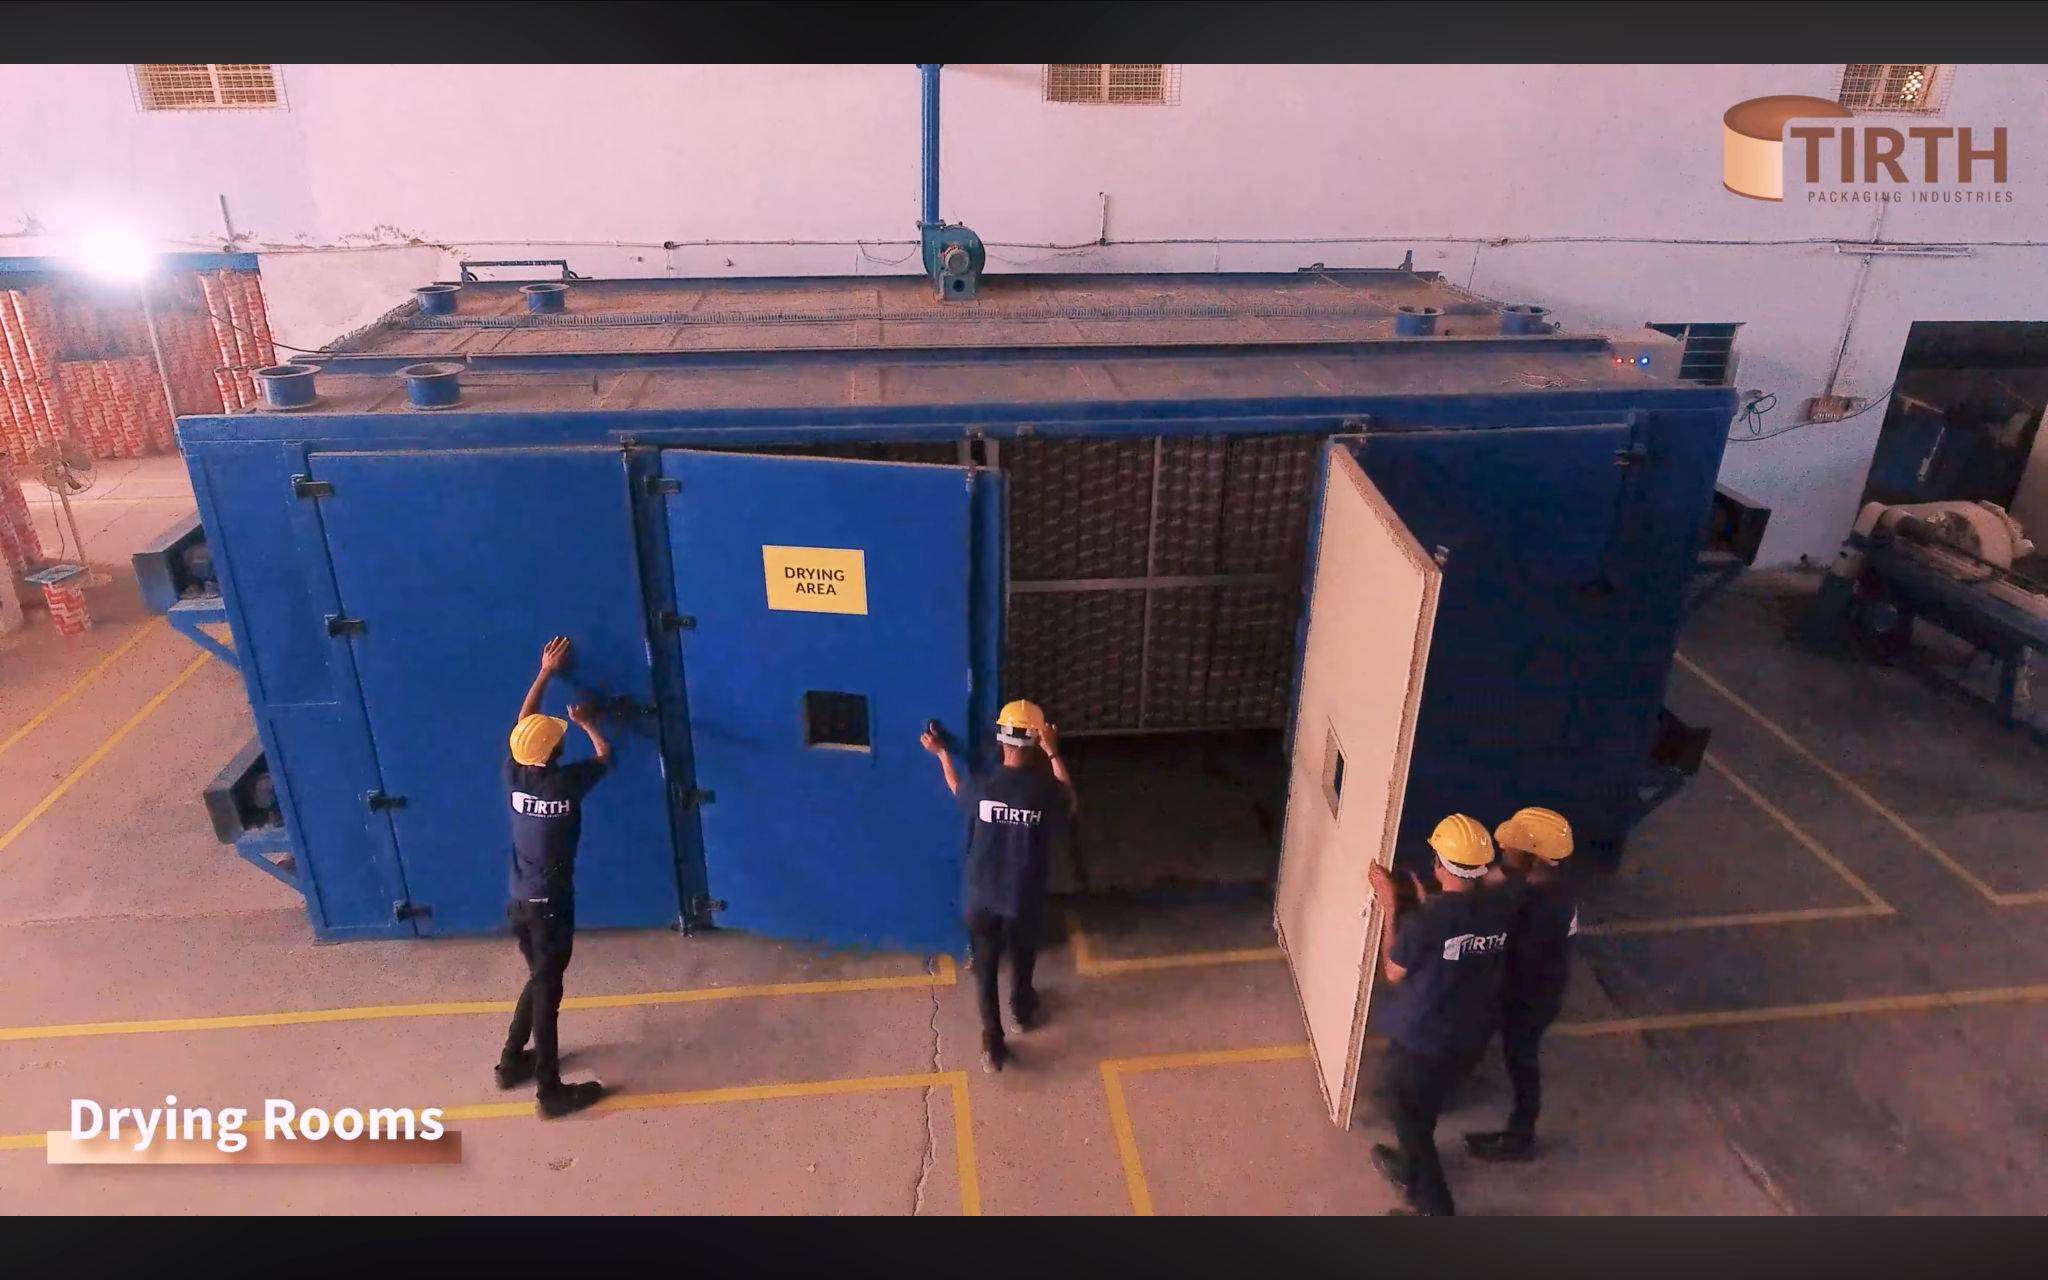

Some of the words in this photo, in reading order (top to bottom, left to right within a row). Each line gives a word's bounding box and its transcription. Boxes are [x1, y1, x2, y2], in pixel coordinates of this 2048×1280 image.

[784, 566, 845, 581] DRYING
[795, 582, 837, 595] AREA
[524, 799, 570, 814] TIRTH
[993, 807, 1041, 822] TIRTH
[1461, 932, 1507, 952] TIRTH
